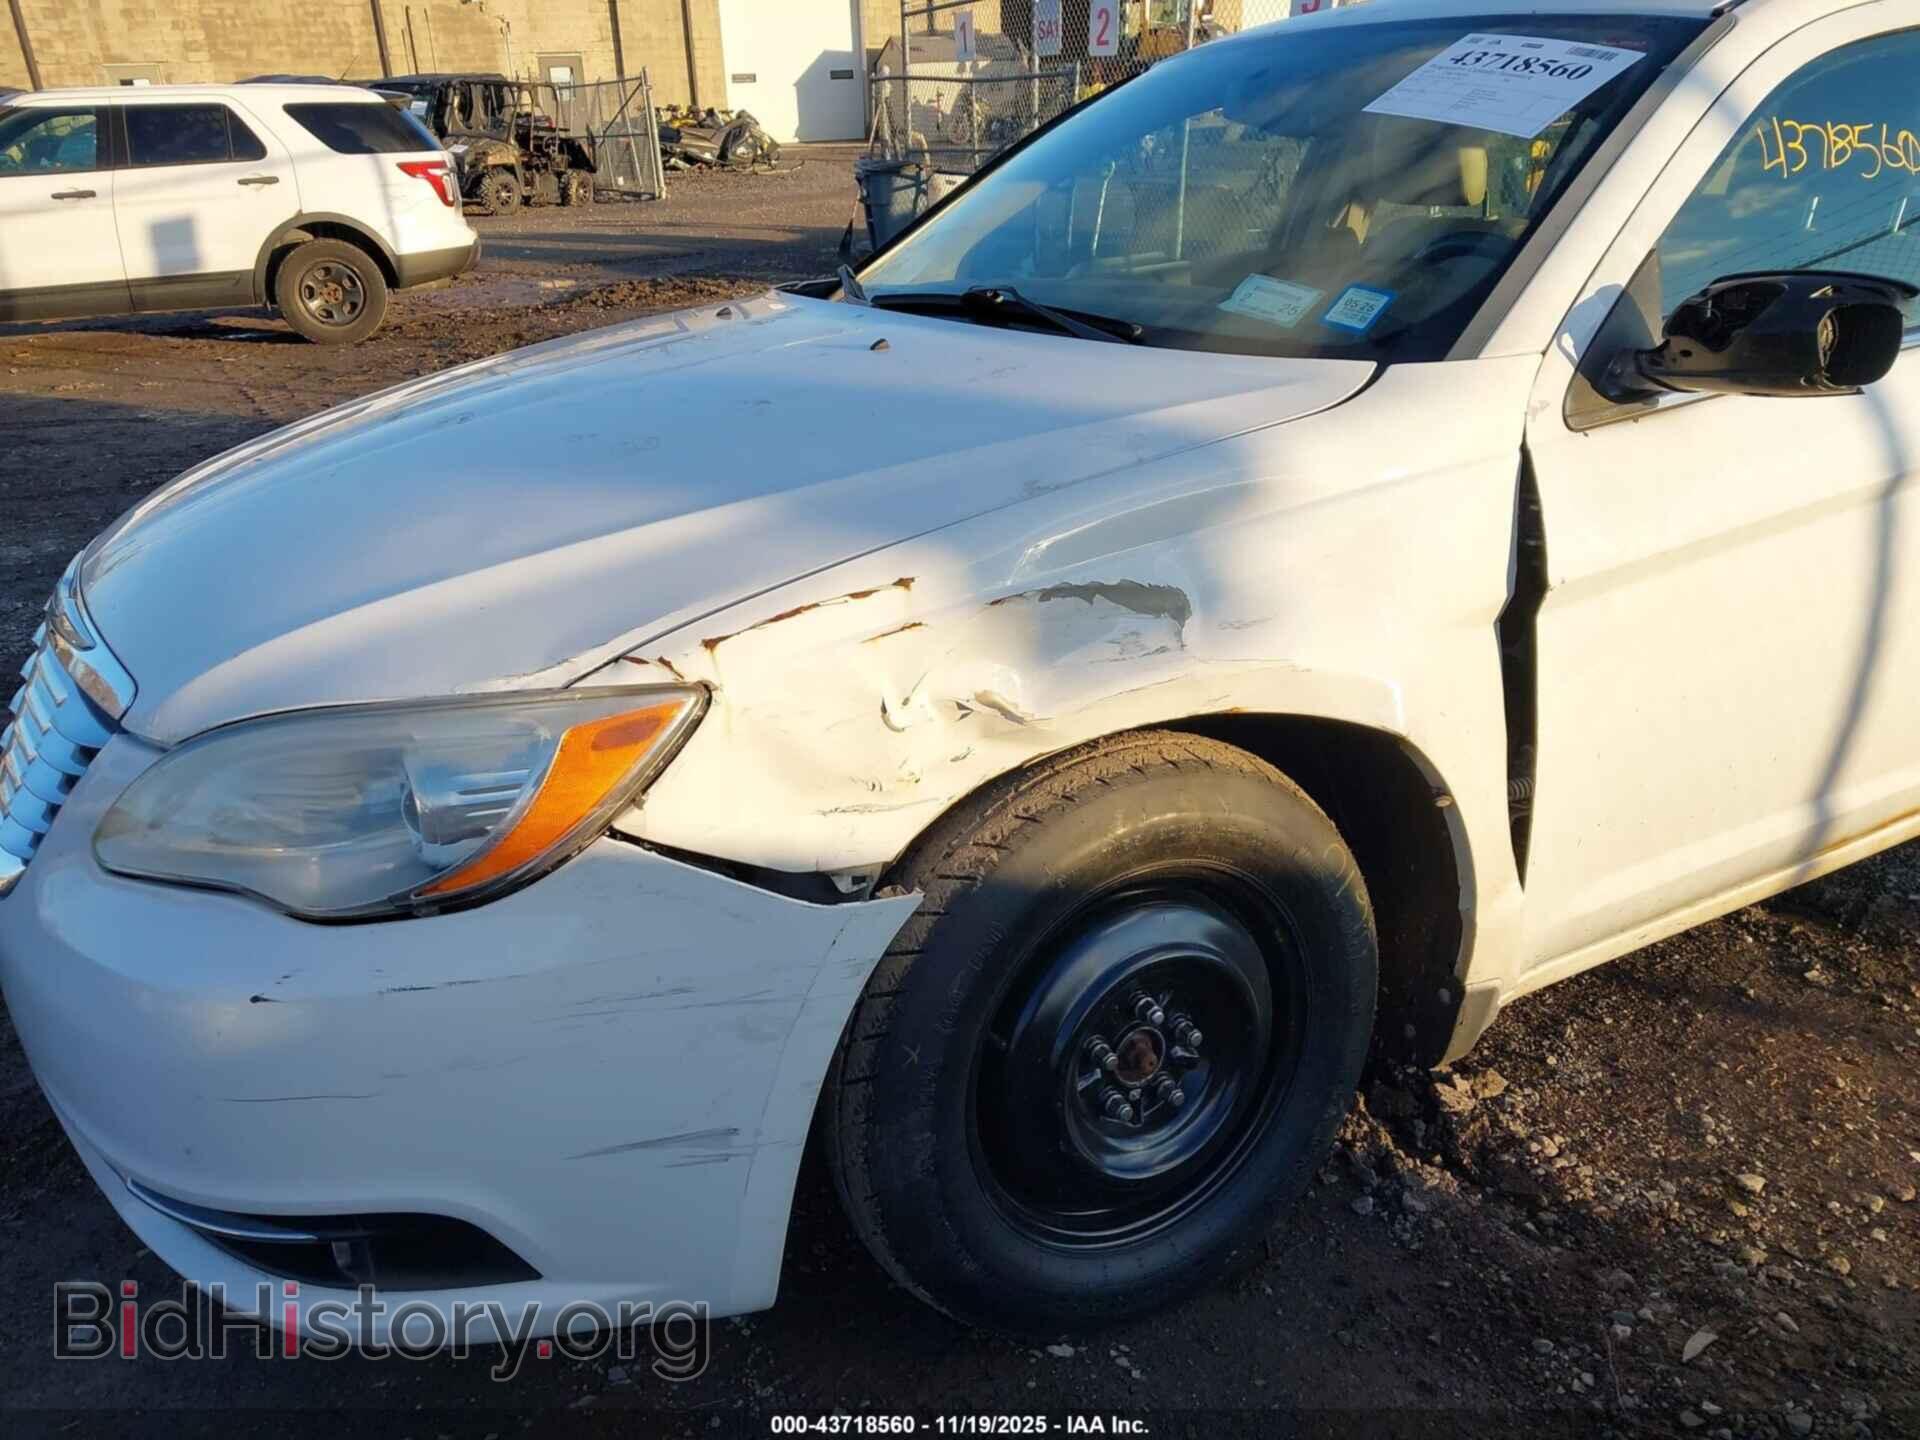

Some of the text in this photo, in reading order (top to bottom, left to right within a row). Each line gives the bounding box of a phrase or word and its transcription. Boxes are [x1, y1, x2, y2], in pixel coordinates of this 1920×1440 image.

[958, 21, 968, 52] 1
[1096, 8, 1110, 47] 2
[1450, 50, 1593, 80] 43718560
